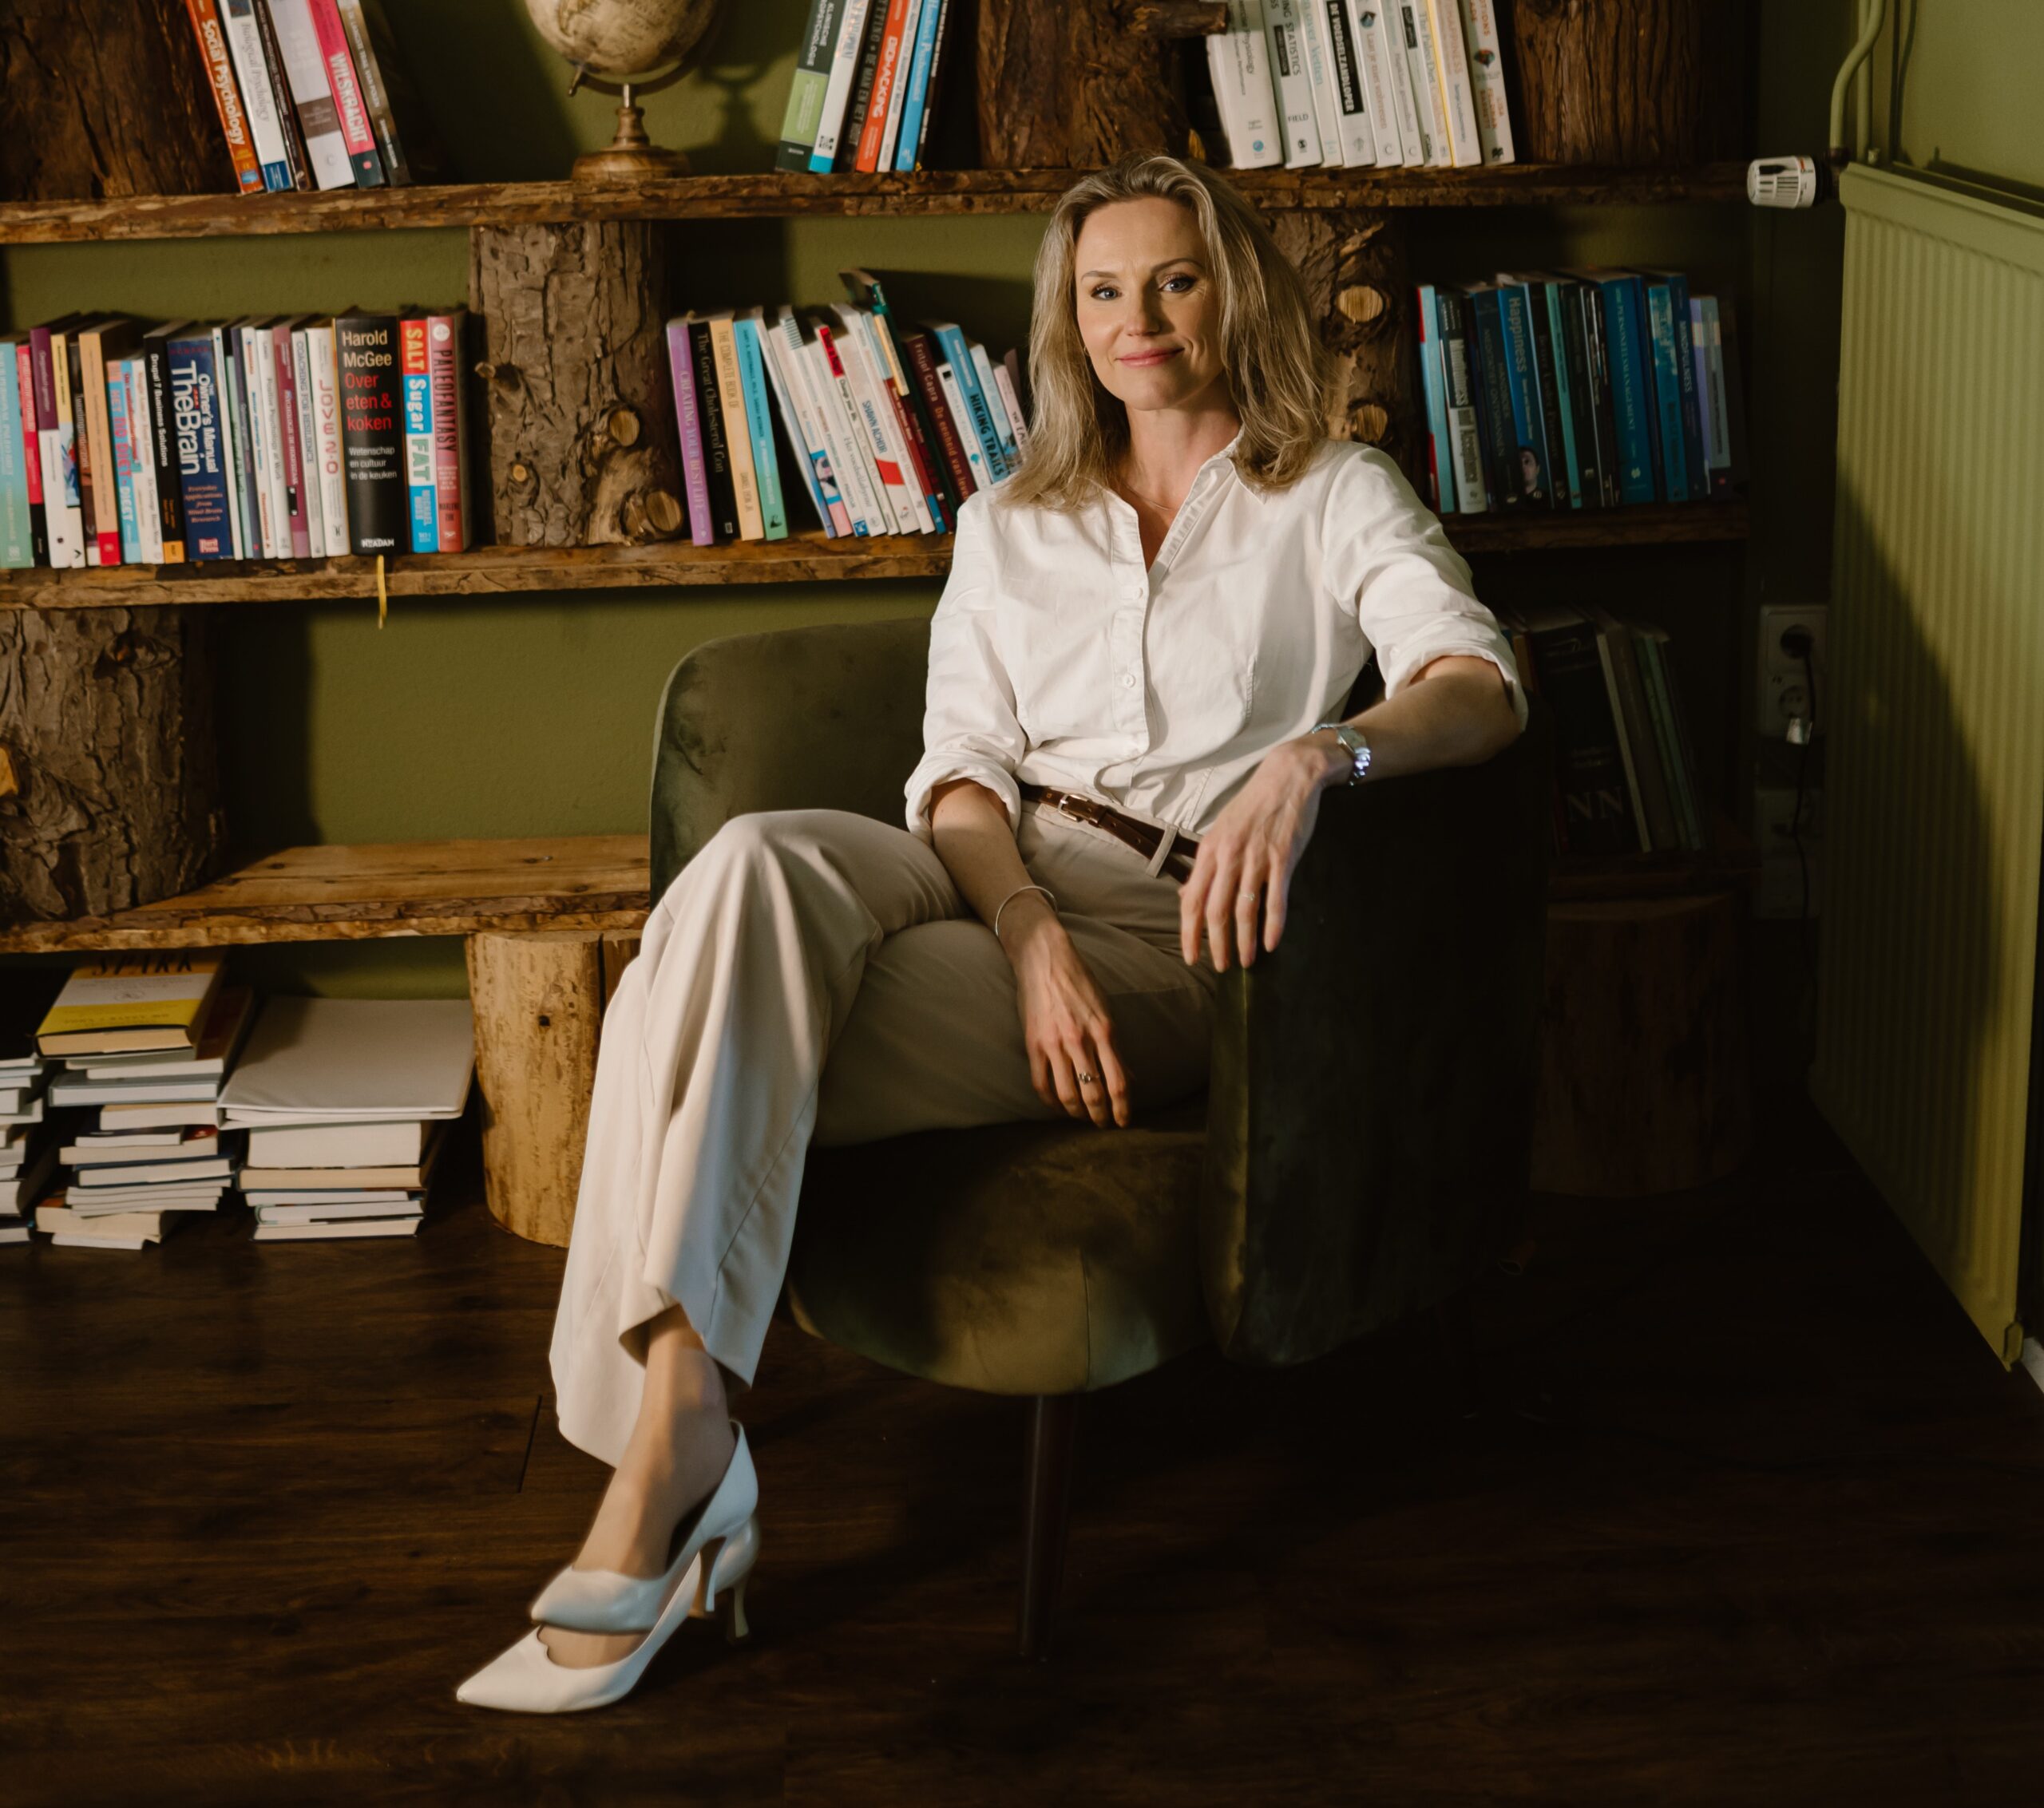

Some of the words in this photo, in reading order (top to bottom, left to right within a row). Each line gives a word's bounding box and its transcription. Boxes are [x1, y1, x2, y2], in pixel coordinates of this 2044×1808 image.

[1329, 2, 1339, 15] DE
[1241, 28, 1254, 73] Physiology
[1285, 22, 1301, 76] STATISTICS
[1312, 45, 1324, 85] Vetten
[1333, 17, 1353, 111] VOEDSELZANDLOPER
[203, 18, 223, 62] Social
[214, 62, 244, 147] Psychology
[250, 69, 271, 122] Psychology
[873, 34, 897, 118] BIOHACKING
[332, 50, 365, 144] WILSKRACHT
[342, 330, 388, 346] Harold
[405, 327, 424, 370] SALT
[697, 332, 711, 354] The
[718, 330, 730, 342] THE
[1507, 296, 1528, 372] Happiness
[149, 352, 160, 381] Drupal
[296, 341, 307, 390] COACHING
[343, 350, 392, 368] McGee
[699, 356, 713, 385] Great
[721, 344, 734, 378] COMPLETE
[1678, 320, 1693, 392] MINDFULNESS
[198, 373, 214, 425] Owner's
[266, 376, 275, 407] Positive
[300, 393, 309, 410] FOR
[345, 372, 379, 390] Over
[346, 395, 378, 410] eten
[381, 393, 392, 409] &
[433, 349, 457, 452] PALEOFANTASY
[680, 370, 694, 425] CREATING
[154, 388, 164, 426] Business
[347, 415, 392, 432] koken
[406, 378, 428, 430] Sugar
[705, 387, 723, 449] Cholesterol
[913, 342, 930, 372] Fritjof
[923, 374, 940, 402] Capra
[934, 406, 945, 418] De
[940, 420, 957, 457] eenheid
[950, 458, 961, 475] van
[158, 427, 168, 466] Solutions
[268, 408, 278, 450] Psychology
[303, 413, 313, 464] RESILIENCE
[686, 427, 699, 457] YOUR
[843, 436, 855, 452] Het
[862, 399, 878, 427] SHAWN
[871, 426, 888, 453] ACHOR
[971, 392, 989, 434] HIKING
[985, 436, 1003, 476] TRAILS
[203, 427, 220, 473] Manual
[349, 446, 395, 457] Wetenschap
[360, 459, 387, 469] cultuur
[411, 438, 430, 481] FAT
[712, 451, 726, 472] Con
[358, 472, 368, 481] de
[370, 471, 397, 481] keuken
[689, 459, 702, 486] BEST
